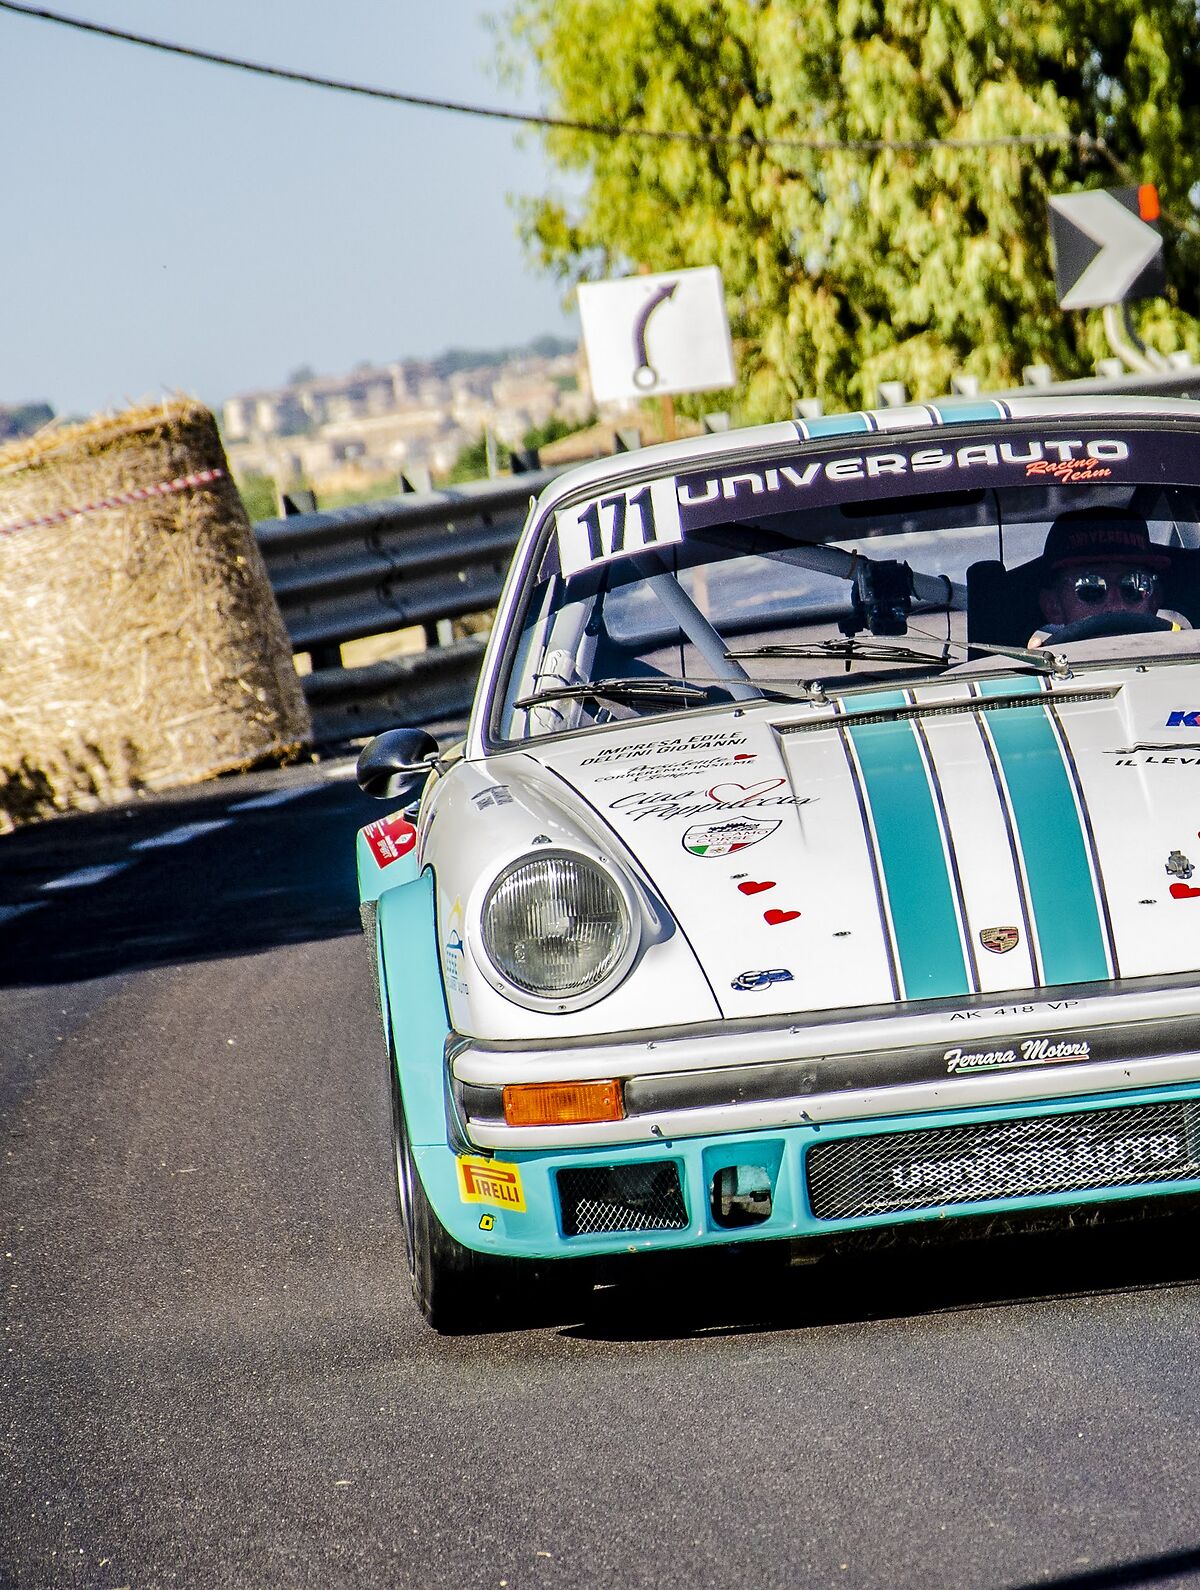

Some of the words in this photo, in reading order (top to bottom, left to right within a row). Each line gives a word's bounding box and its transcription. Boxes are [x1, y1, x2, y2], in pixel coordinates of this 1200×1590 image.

[678, 439, 1130, 506] UNIVERSAUTO
[1026, 457, 1099, 477] Racing
[1054, 467, 1112, 483] Team
[577, 485, 659, 561] 171
[580, 748, 653, 766] DELFINI
[657, 738, 748, 755] GIOVANNI
[597, 738, 682, 757] IMPRESA
[688, 731, 744, 744] EDILE
[593, 766, 688, 783] CORREREMO
[693, 759, 756, 770] INSIEME
[1115, 759, 1138, 767] IL
[608, 790, 706, 809] Ciao
[950, 1010, 982, 1021] AK
[994, 1005, 1035, 1016] 418
[1047, 1000, 1080, 1010] VP
[943, 1048, 1017, 1074] Ferrara
[1020, 1038, 1091, 1061] Motors
[462, 1163, 521, 1204] PIRELLI
